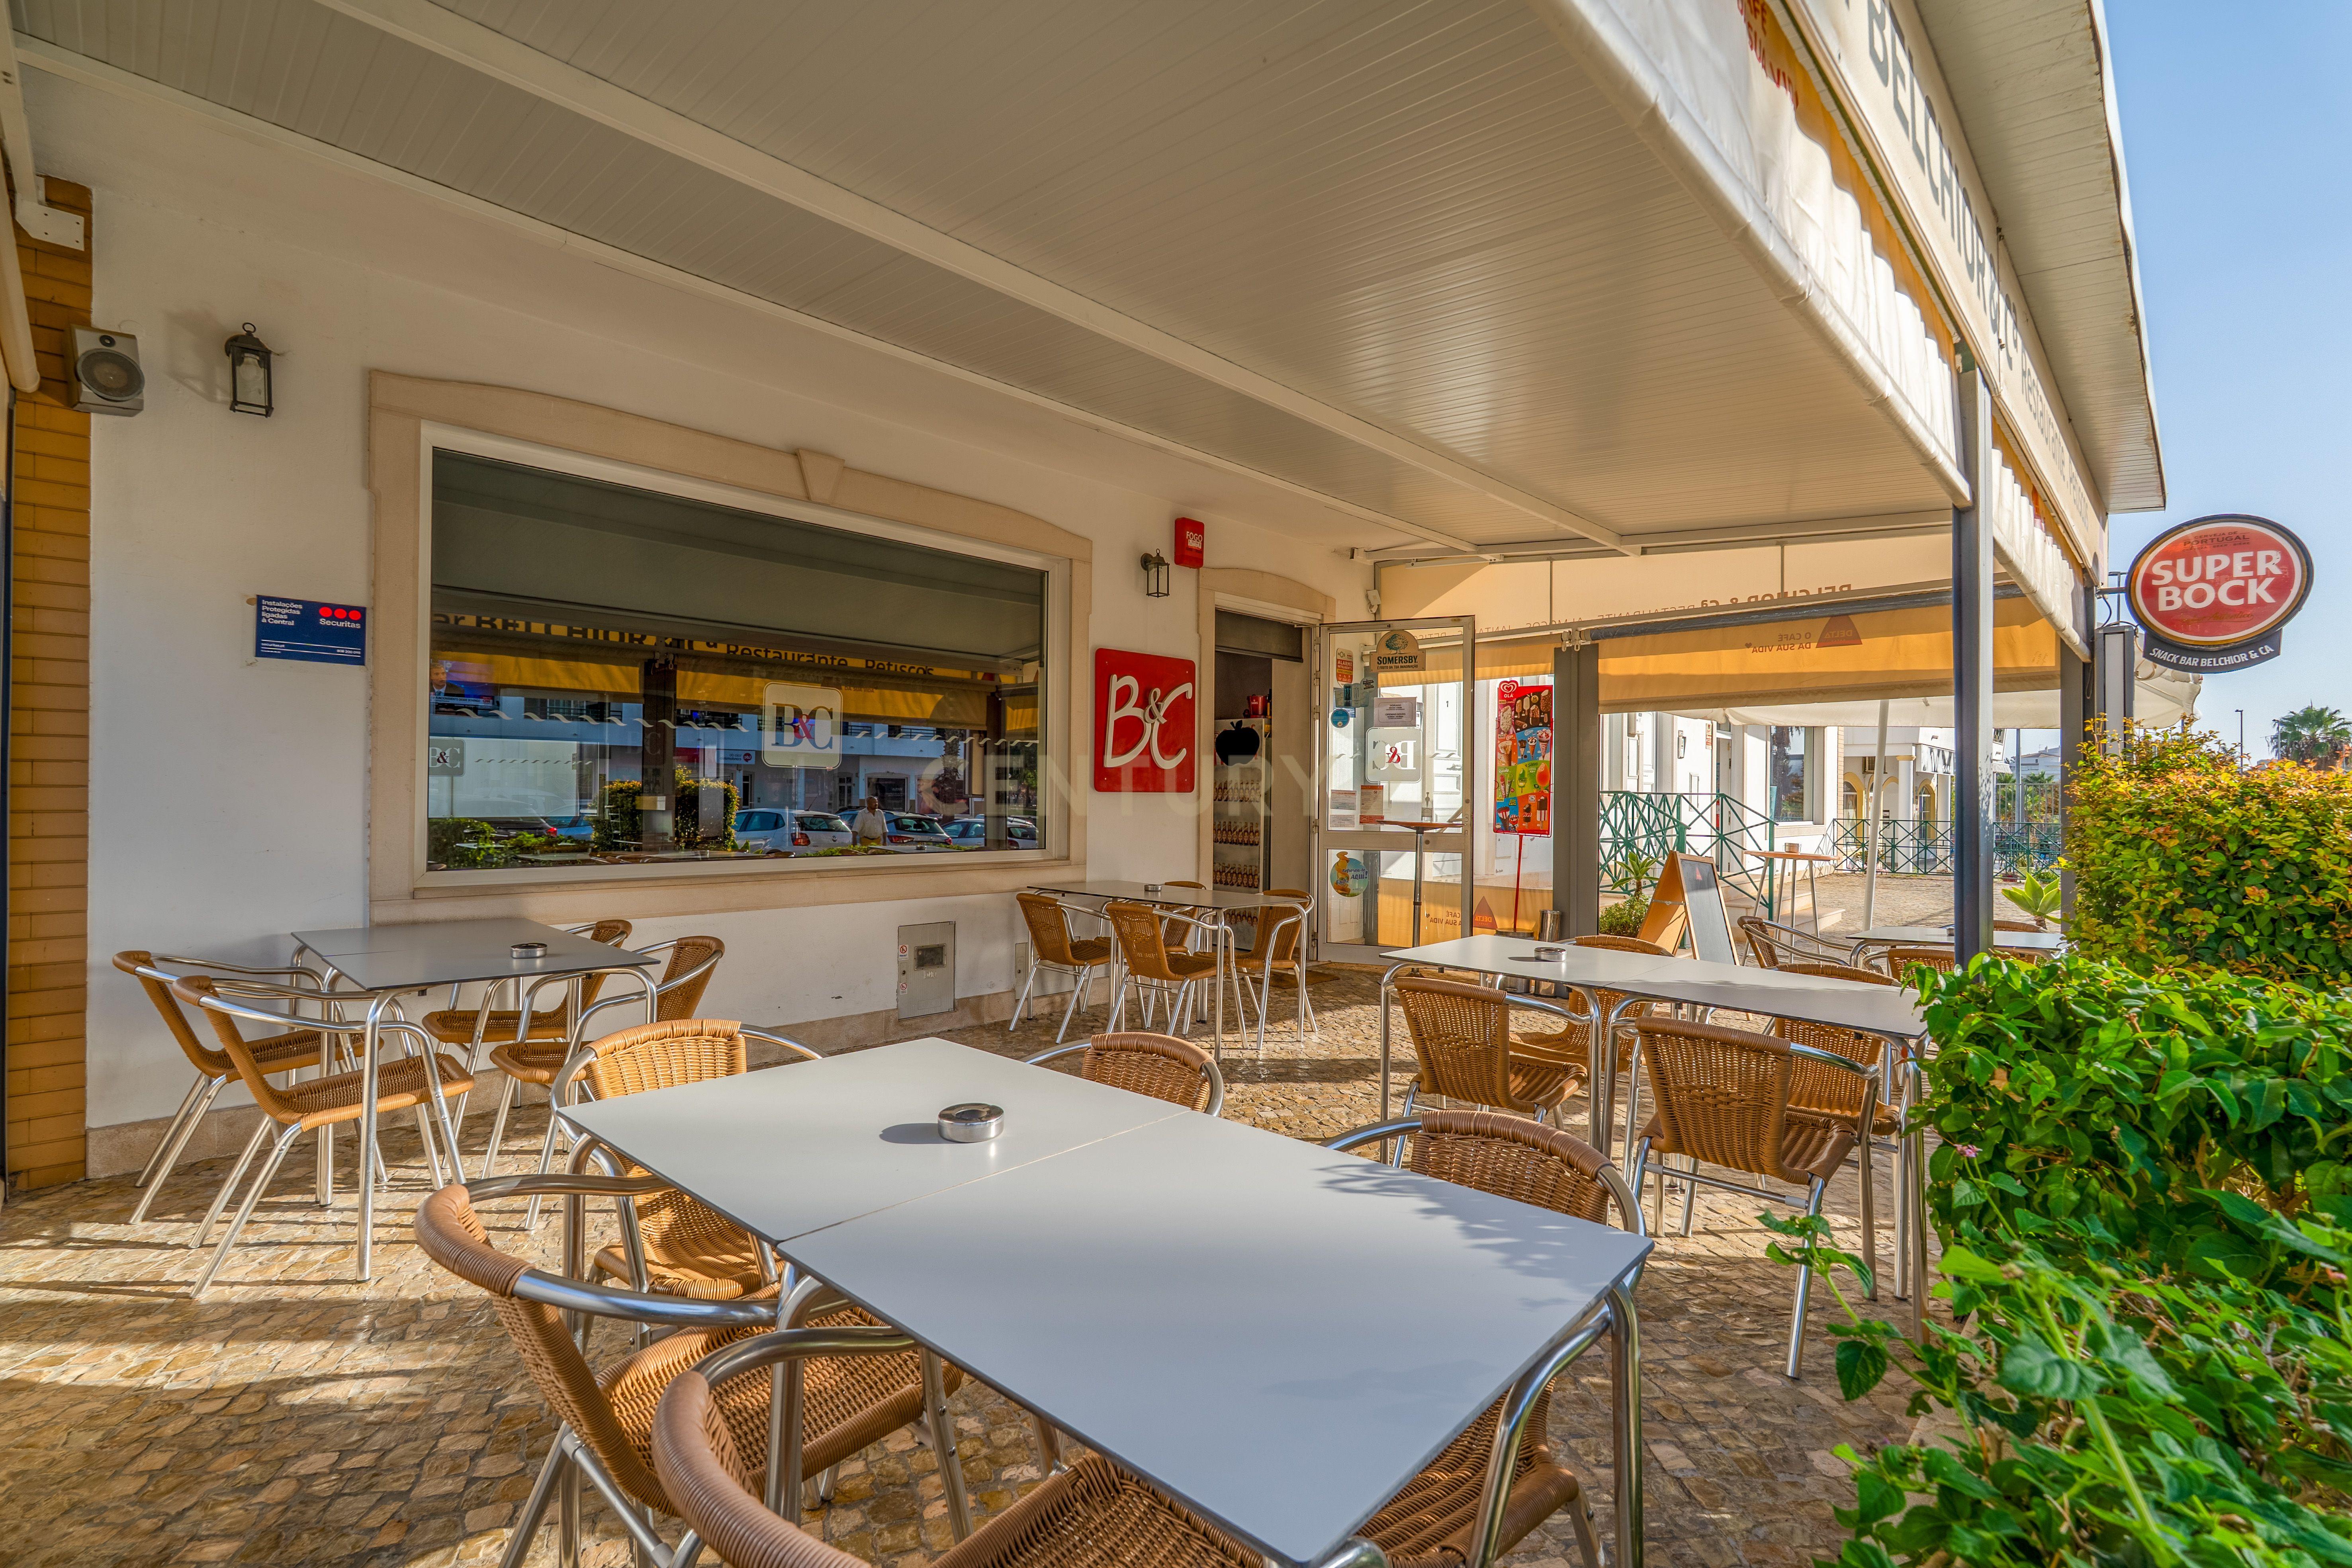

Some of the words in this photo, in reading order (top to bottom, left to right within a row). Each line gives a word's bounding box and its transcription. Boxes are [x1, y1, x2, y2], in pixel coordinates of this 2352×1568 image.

[1186, 531, 1203, 542] FOGO
[2184, 534, 2250, 546] PORTUGAL
[2152, 550, 2283, 586] SUPER
[2158, 577, 2276, 612] BOCK
[262, 599, 303, 609] Instalações
[262, 605, 301, 615] Protegidas
[319, 618, 361, 628] Securitas
[2149, 648, 2180, 663] SNACK
[2178, 656, 2198, 666] BAR
[2200, 653, 2249, 667] BELCHIOR
[2248, 650, 2259, 659] &
[2258, 645, 2274, 655] CA
